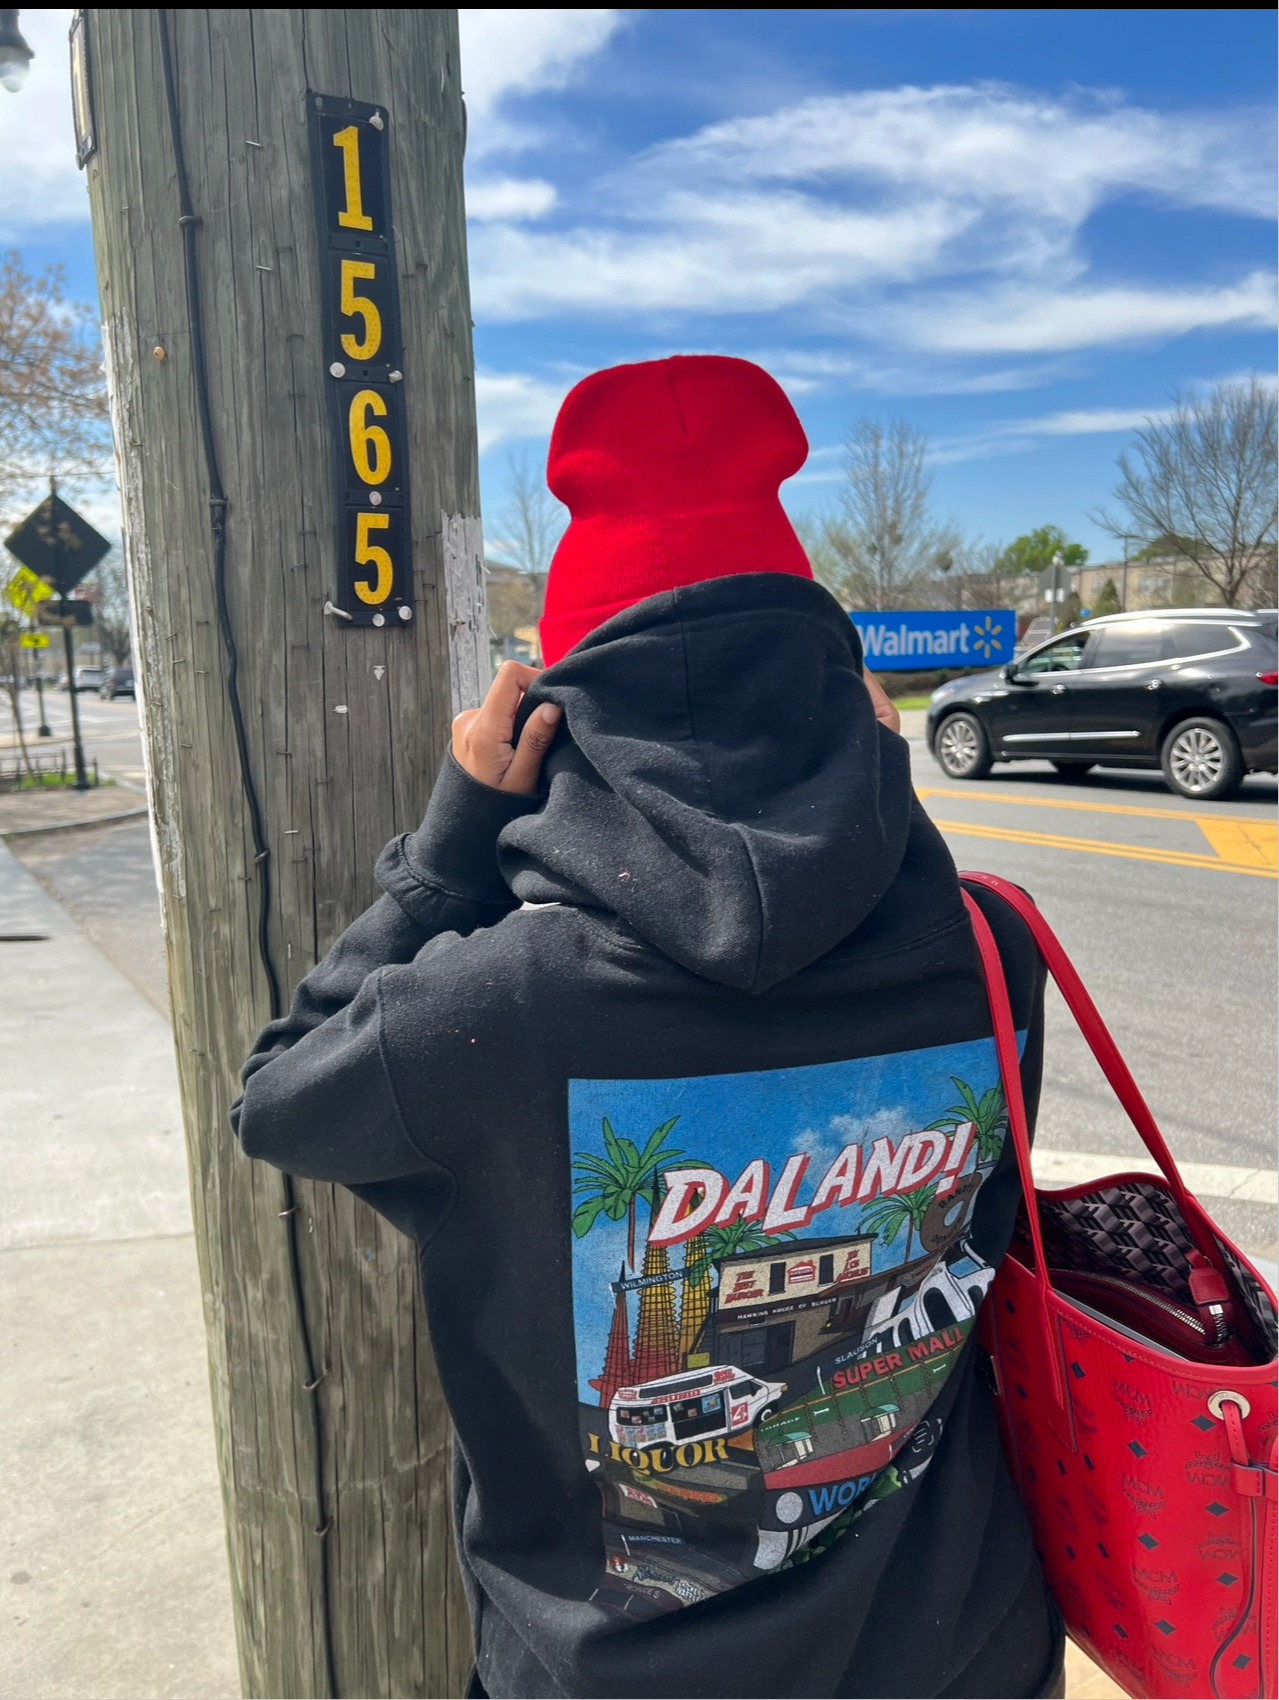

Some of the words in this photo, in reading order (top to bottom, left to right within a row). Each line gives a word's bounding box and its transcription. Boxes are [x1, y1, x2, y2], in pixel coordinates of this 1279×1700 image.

[333, 126, 393, 605] 1565
[856, 622, 970, 657] Walmart
[647, 1122, 977, 1246] DALAND!
[620, 1271, 683, 1290] WILMINGTON
[737, 1310, 769, 1320] HAWKINS
[772, 1305, 794, 1314] HOUSE
[832, 1352, 903, 1389] SUPER
[906, 1326, 966, 1362] MALL
[834, 1336, 879, 1365] SLAUSON
[1112, 1378, 1151, 1405] MCM
[1121, 1471, 1165, 1498] MCM
[1186, 1471, 1231, 1487] MCM
[628, 1535, 683, 1544] MANCHESTER
[1199, 1549, 1241, 1560] MCM
[1132, 1563, 1178, 1583] MCM
